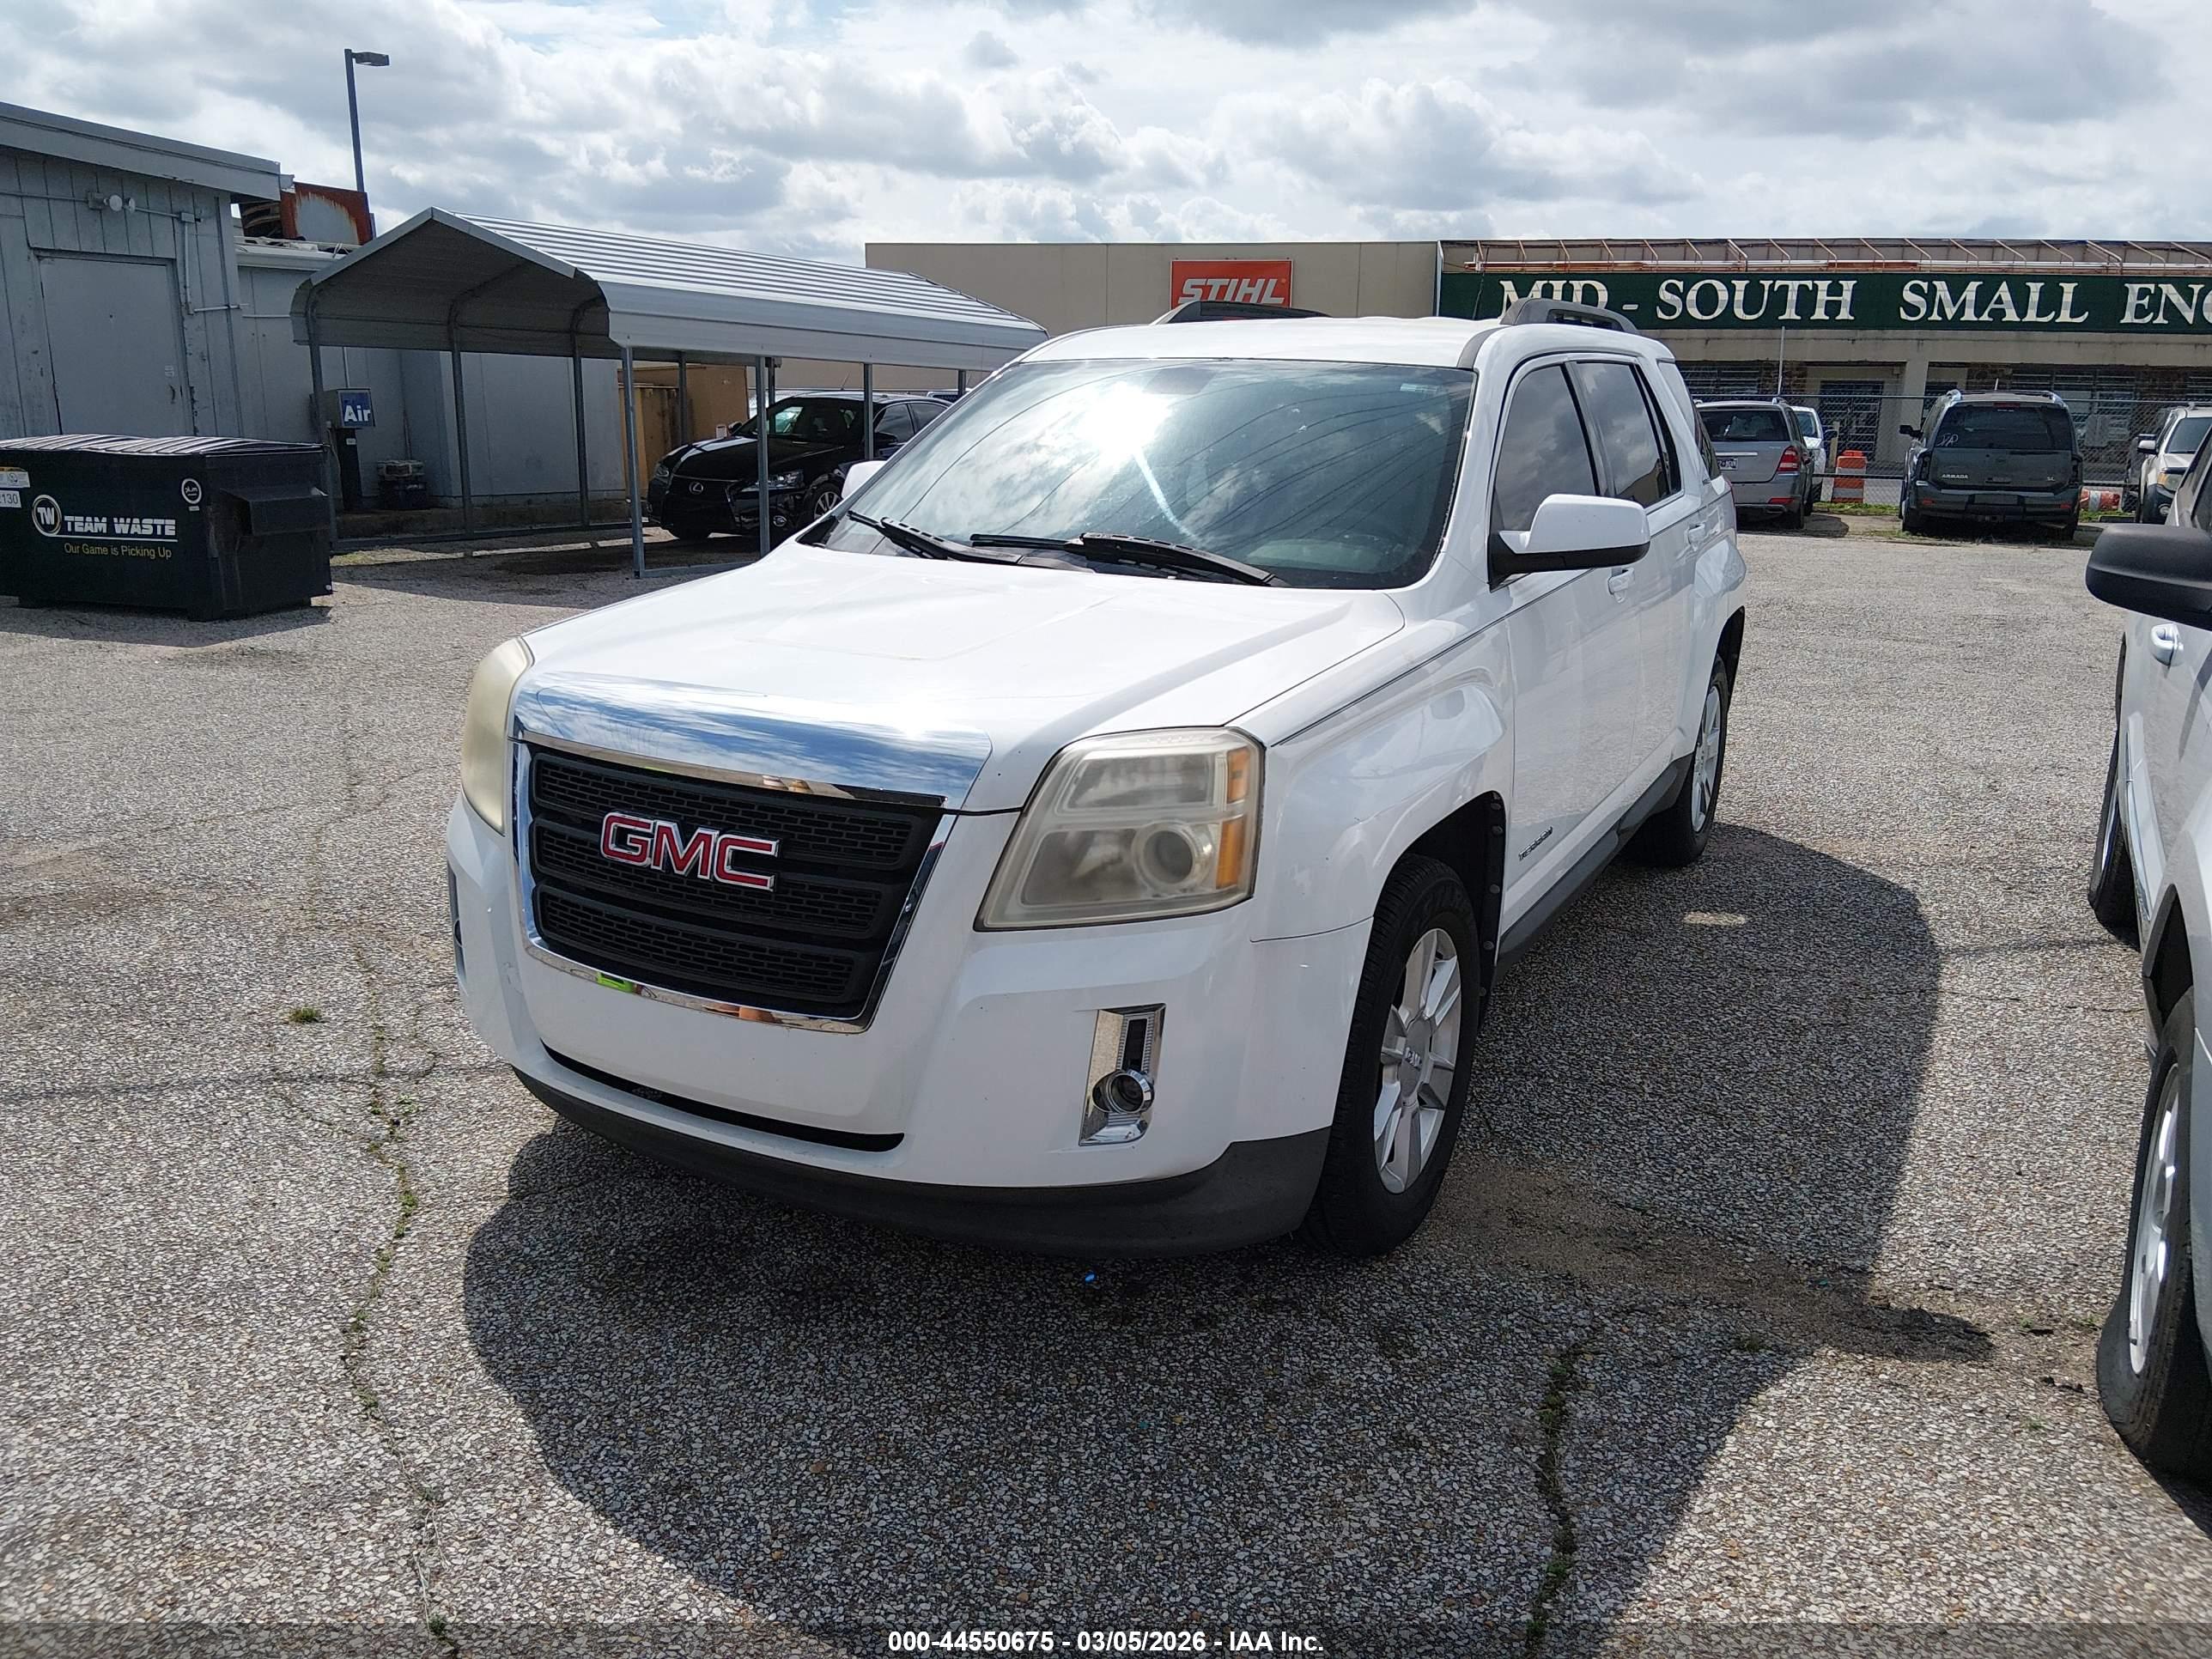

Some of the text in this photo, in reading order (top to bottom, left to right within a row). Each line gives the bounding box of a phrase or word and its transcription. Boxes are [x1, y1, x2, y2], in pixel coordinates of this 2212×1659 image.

[1178, 278, 1285, 303] STIHL
[1656, 279, 1857, 321] SOUTH
[1899, 281, 2089, 323] SMALL
[2119, 283, 2212, 325] EN
[344, 404, 371, 422] Air
[64, 515, 176, 536] TEAM WASTE
[64, 543, 172, 560] Our Game is Picking Up
[601, 811, 779, 891] GMC
